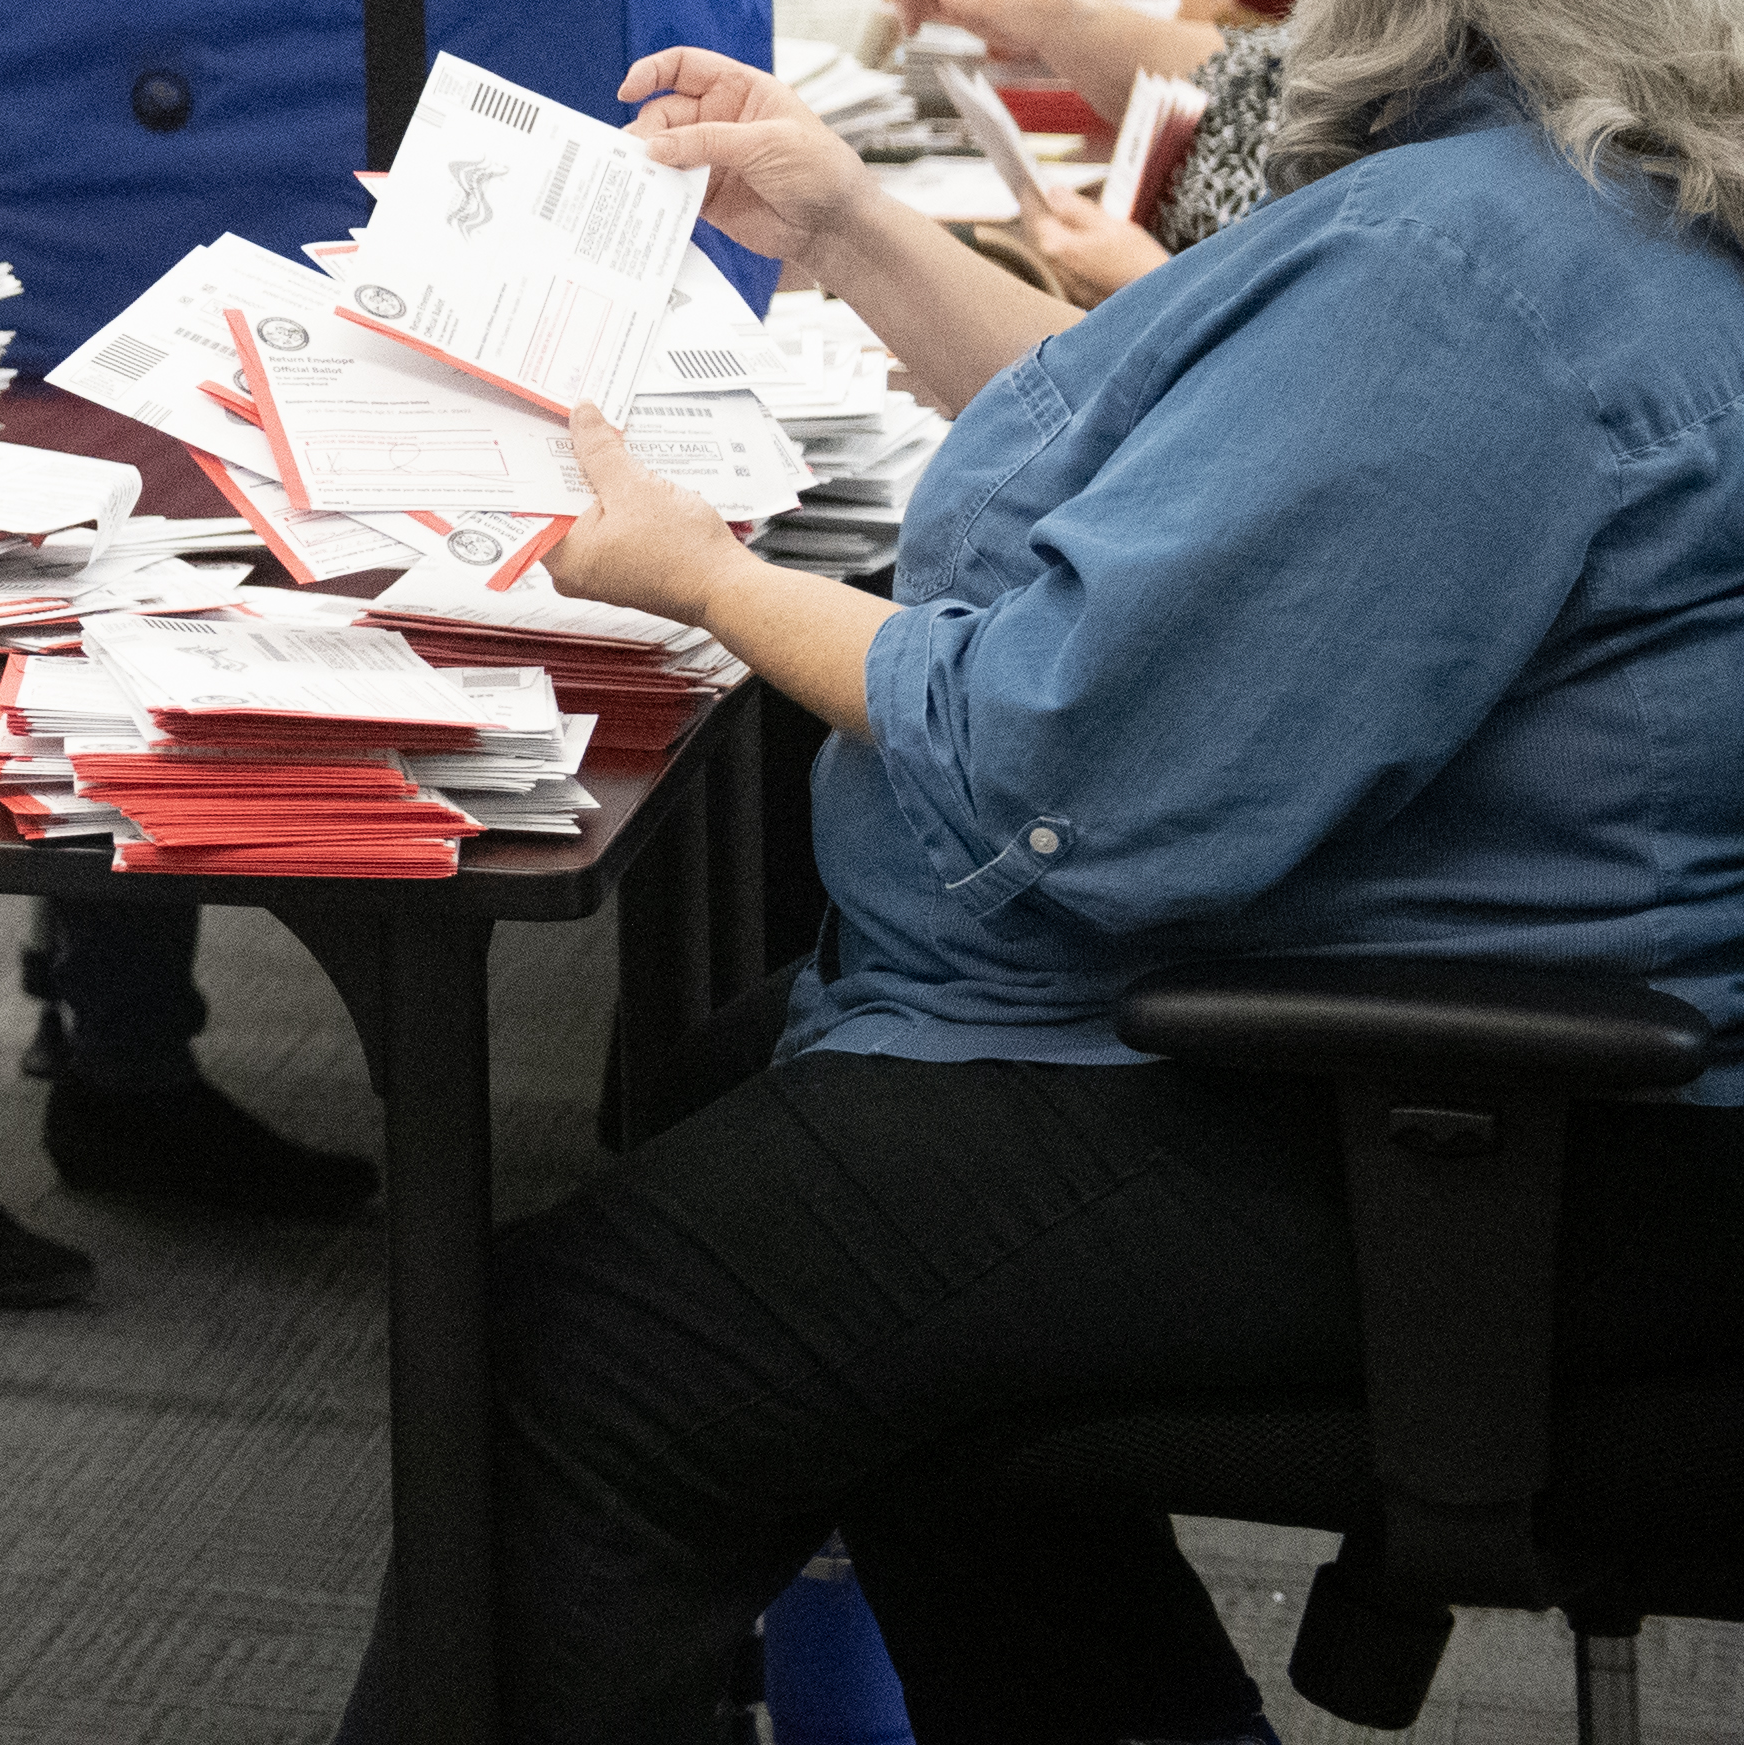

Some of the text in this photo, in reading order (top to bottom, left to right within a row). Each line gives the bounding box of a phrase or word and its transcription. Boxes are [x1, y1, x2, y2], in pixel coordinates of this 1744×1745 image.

[579, 213, 603, 256] BUSINESS
[596, 187, 613, 213] REPLY
[606, 168, 622, 187] MAIL
[268, 355, 355, 366] Return Envelope
[272, 366, 343, 375] Official Ballot
[629, 442, 713, 454] REPLY MAIL
[671, 468, 719, 476] RECORDER
